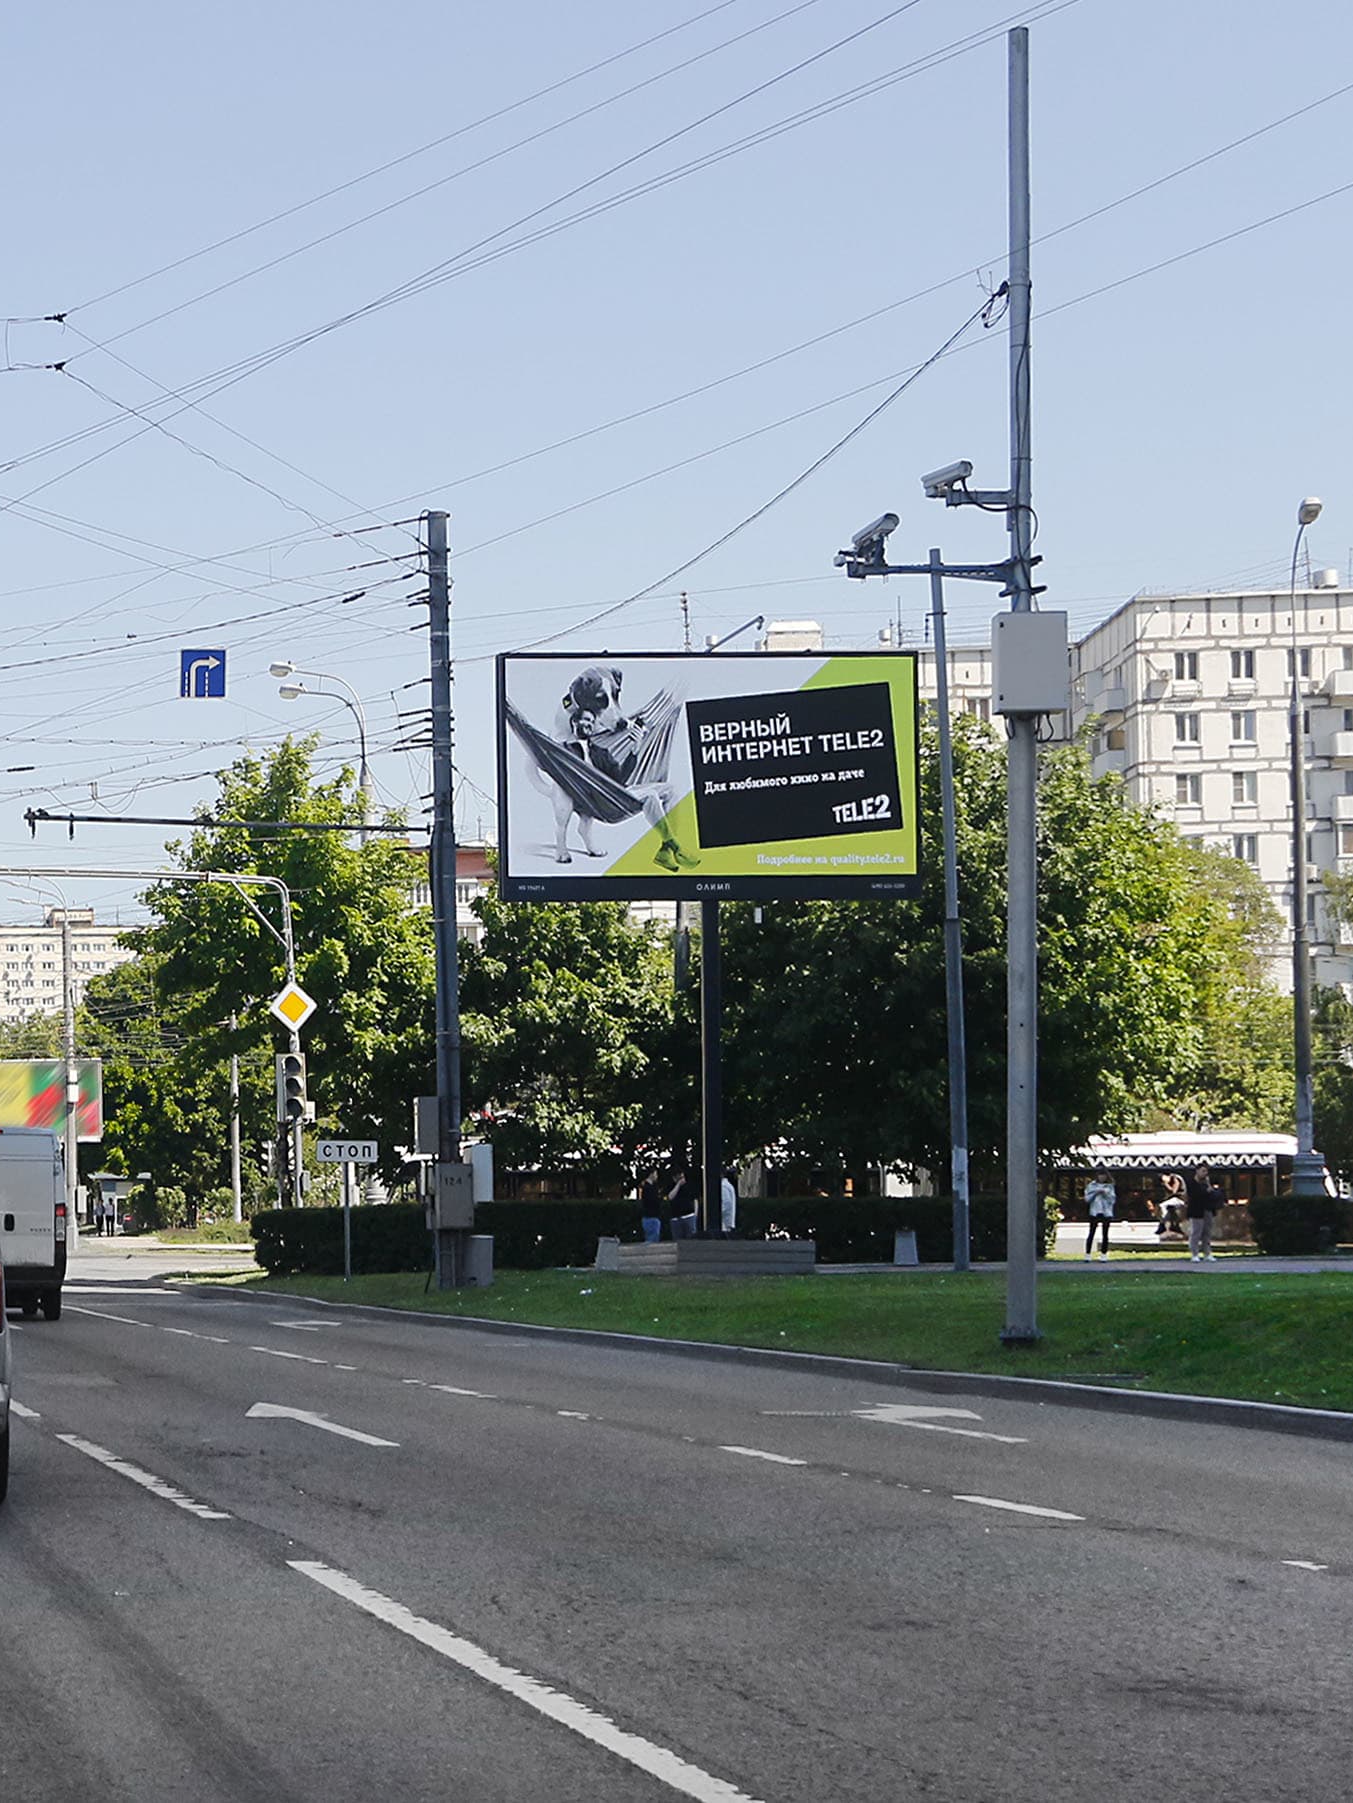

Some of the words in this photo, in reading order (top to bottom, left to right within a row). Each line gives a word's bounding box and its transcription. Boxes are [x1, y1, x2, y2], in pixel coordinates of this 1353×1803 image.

[699, 712, 791, 742] ВЕРНЫЙ
[701, 736, 813, 764] ИНТЕРНЕТ
[818, 730, 884, 752] TELE2
[704, 781, 727, 795] Для
[729, 777, 789, 791] любимого
[790, 772, 819, 785] кино
[821, 772, 836, 781] на
[838, 769, 865, 781] даче
[832, 794, 892, 823] TELE2
[696, 883, 731, 891] ОЛИМП
[323, 1145, 371, 1157] СТОП
